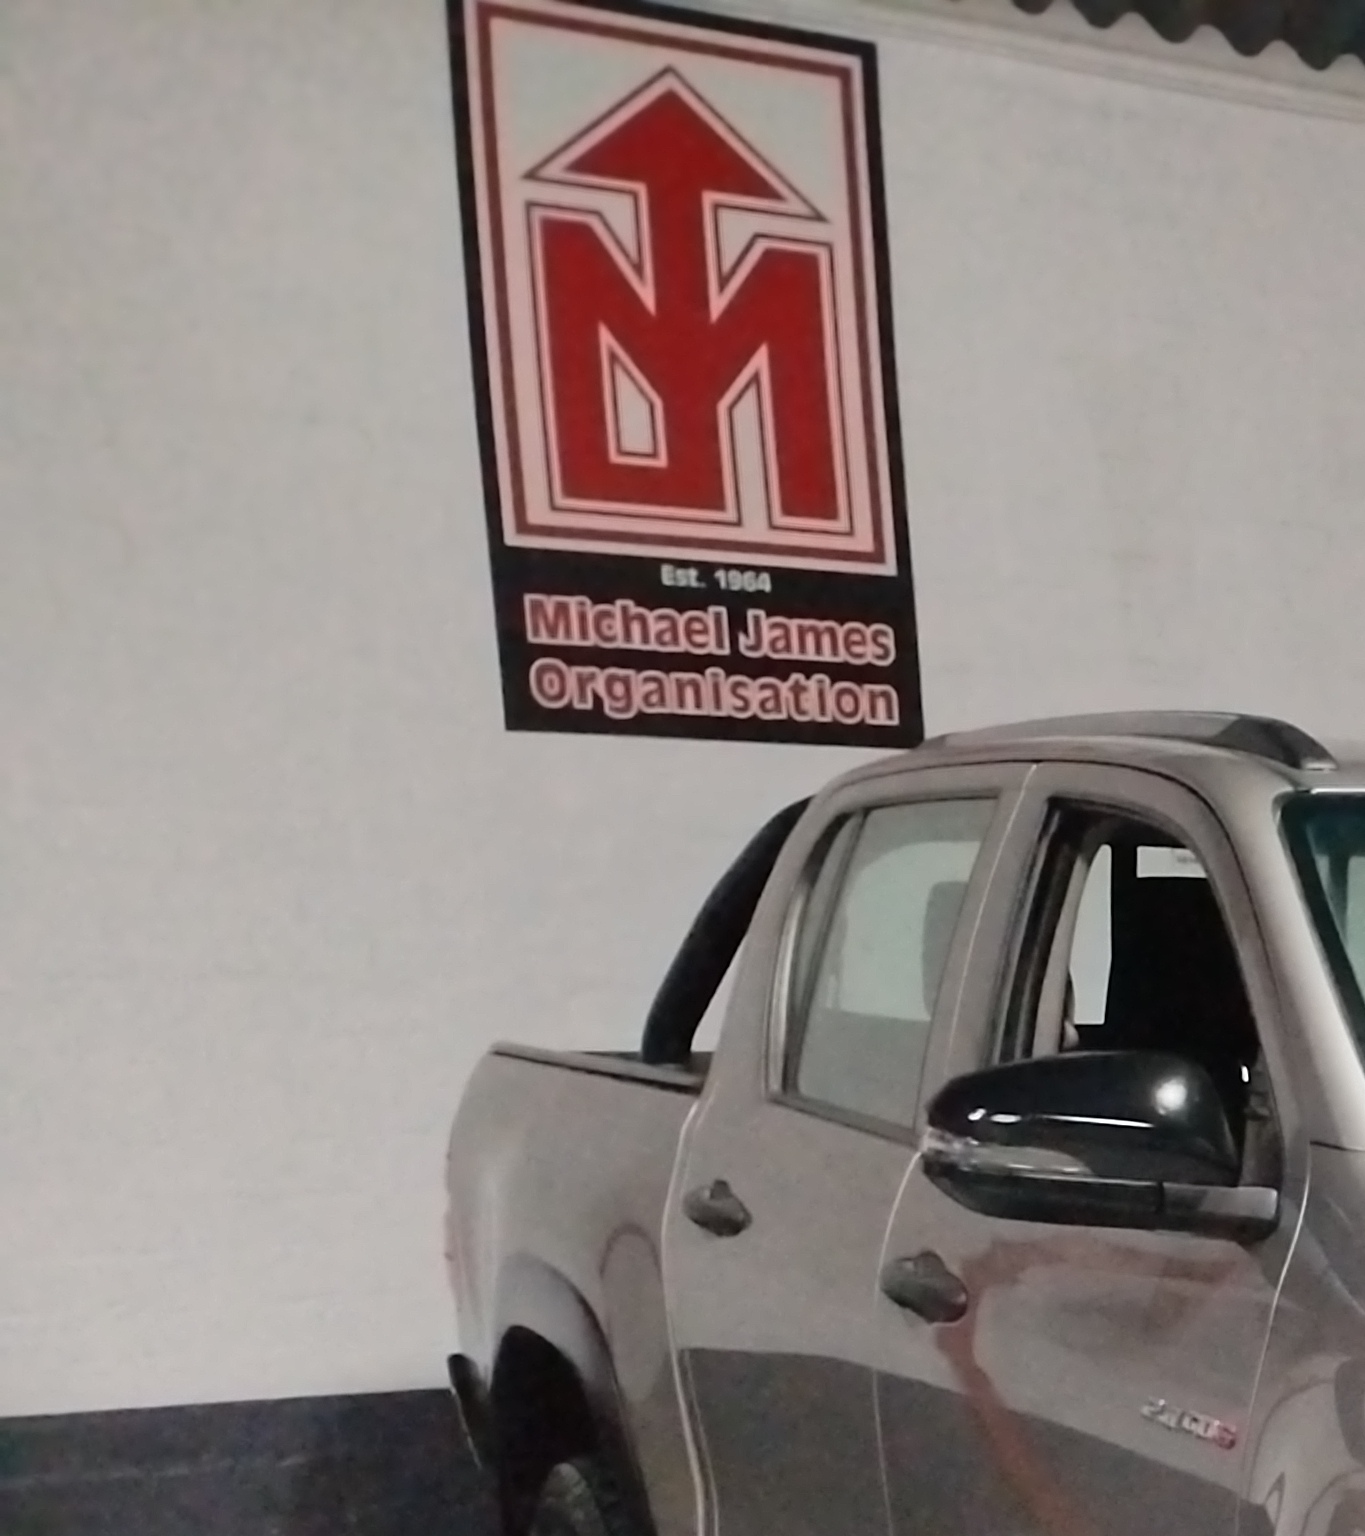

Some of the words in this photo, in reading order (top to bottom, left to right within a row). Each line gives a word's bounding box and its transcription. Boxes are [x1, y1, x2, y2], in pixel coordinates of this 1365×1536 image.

[661, 564, 707, 588] Est.
[714, 568, 772, 593] 1964
[524, 593, 731, 655] Michael
[738, 609, 896, 667] James
[529, 657, 900, 726] Organisation
